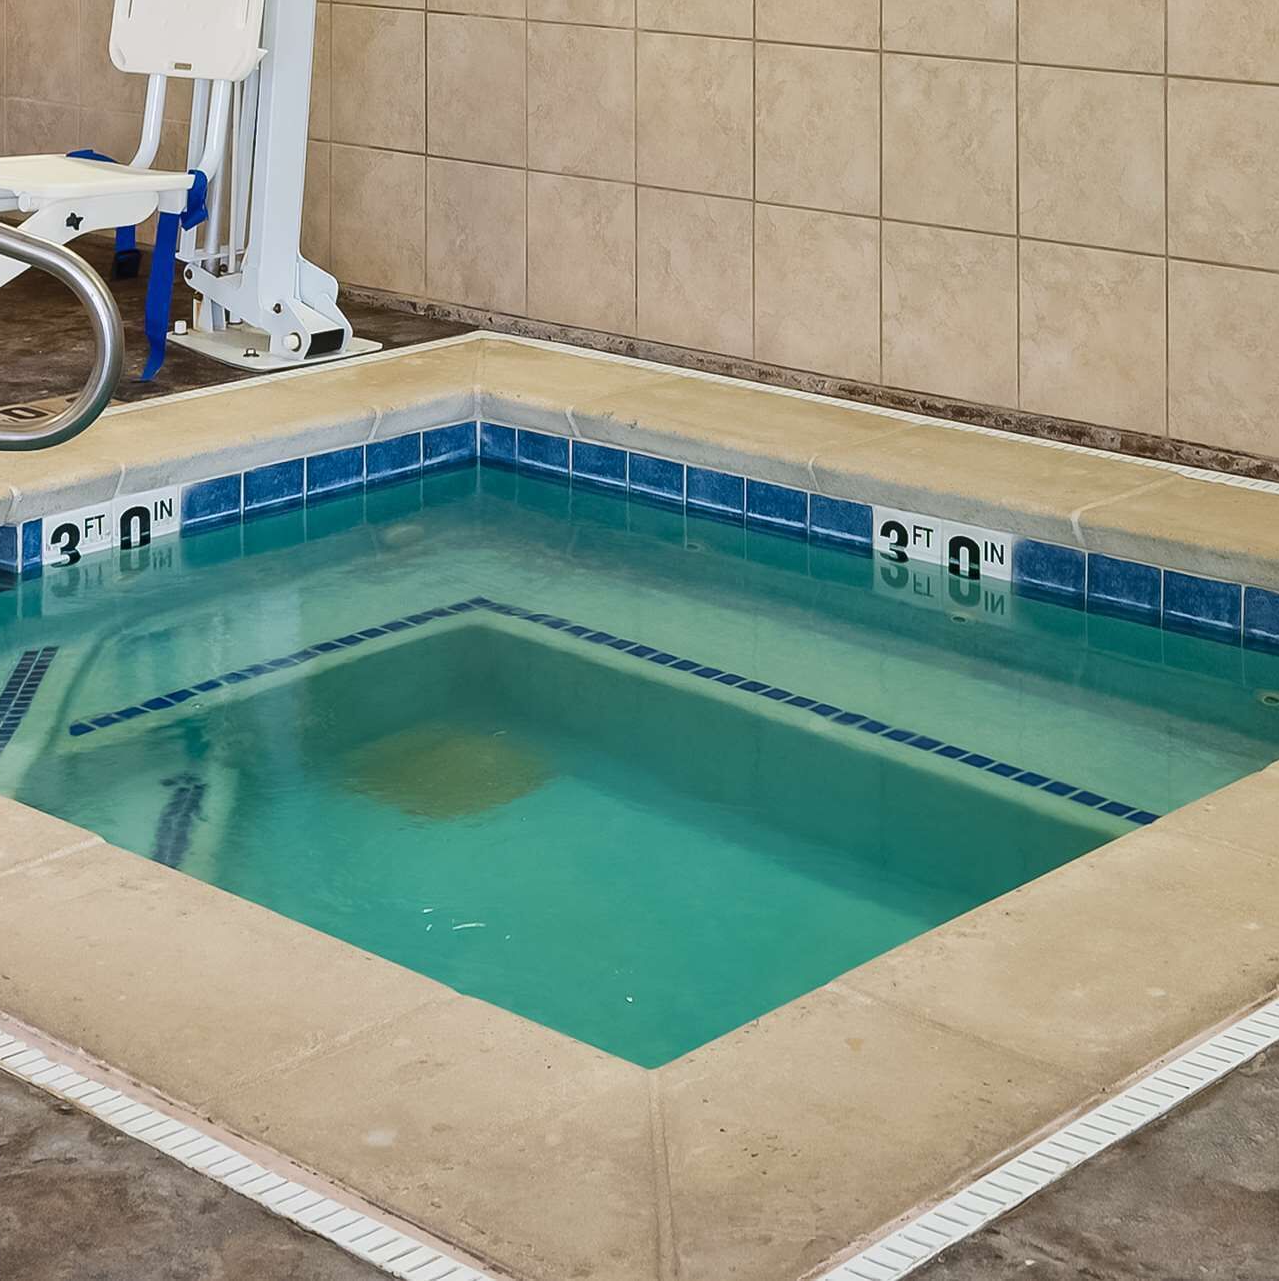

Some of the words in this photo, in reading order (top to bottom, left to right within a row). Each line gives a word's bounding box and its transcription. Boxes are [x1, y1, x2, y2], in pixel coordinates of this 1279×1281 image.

[50, 523, 81, 568] 3
[85, 514, 105, 538] FT
[120, 506, 151, 550] 0
[154, 498, 173, 521] IN
[880, 520, 909, 563] 3
[913, 525, 934, 548] FT
[948, 535, 981, 580] 0
[984, 540, 1004, 565] IN
